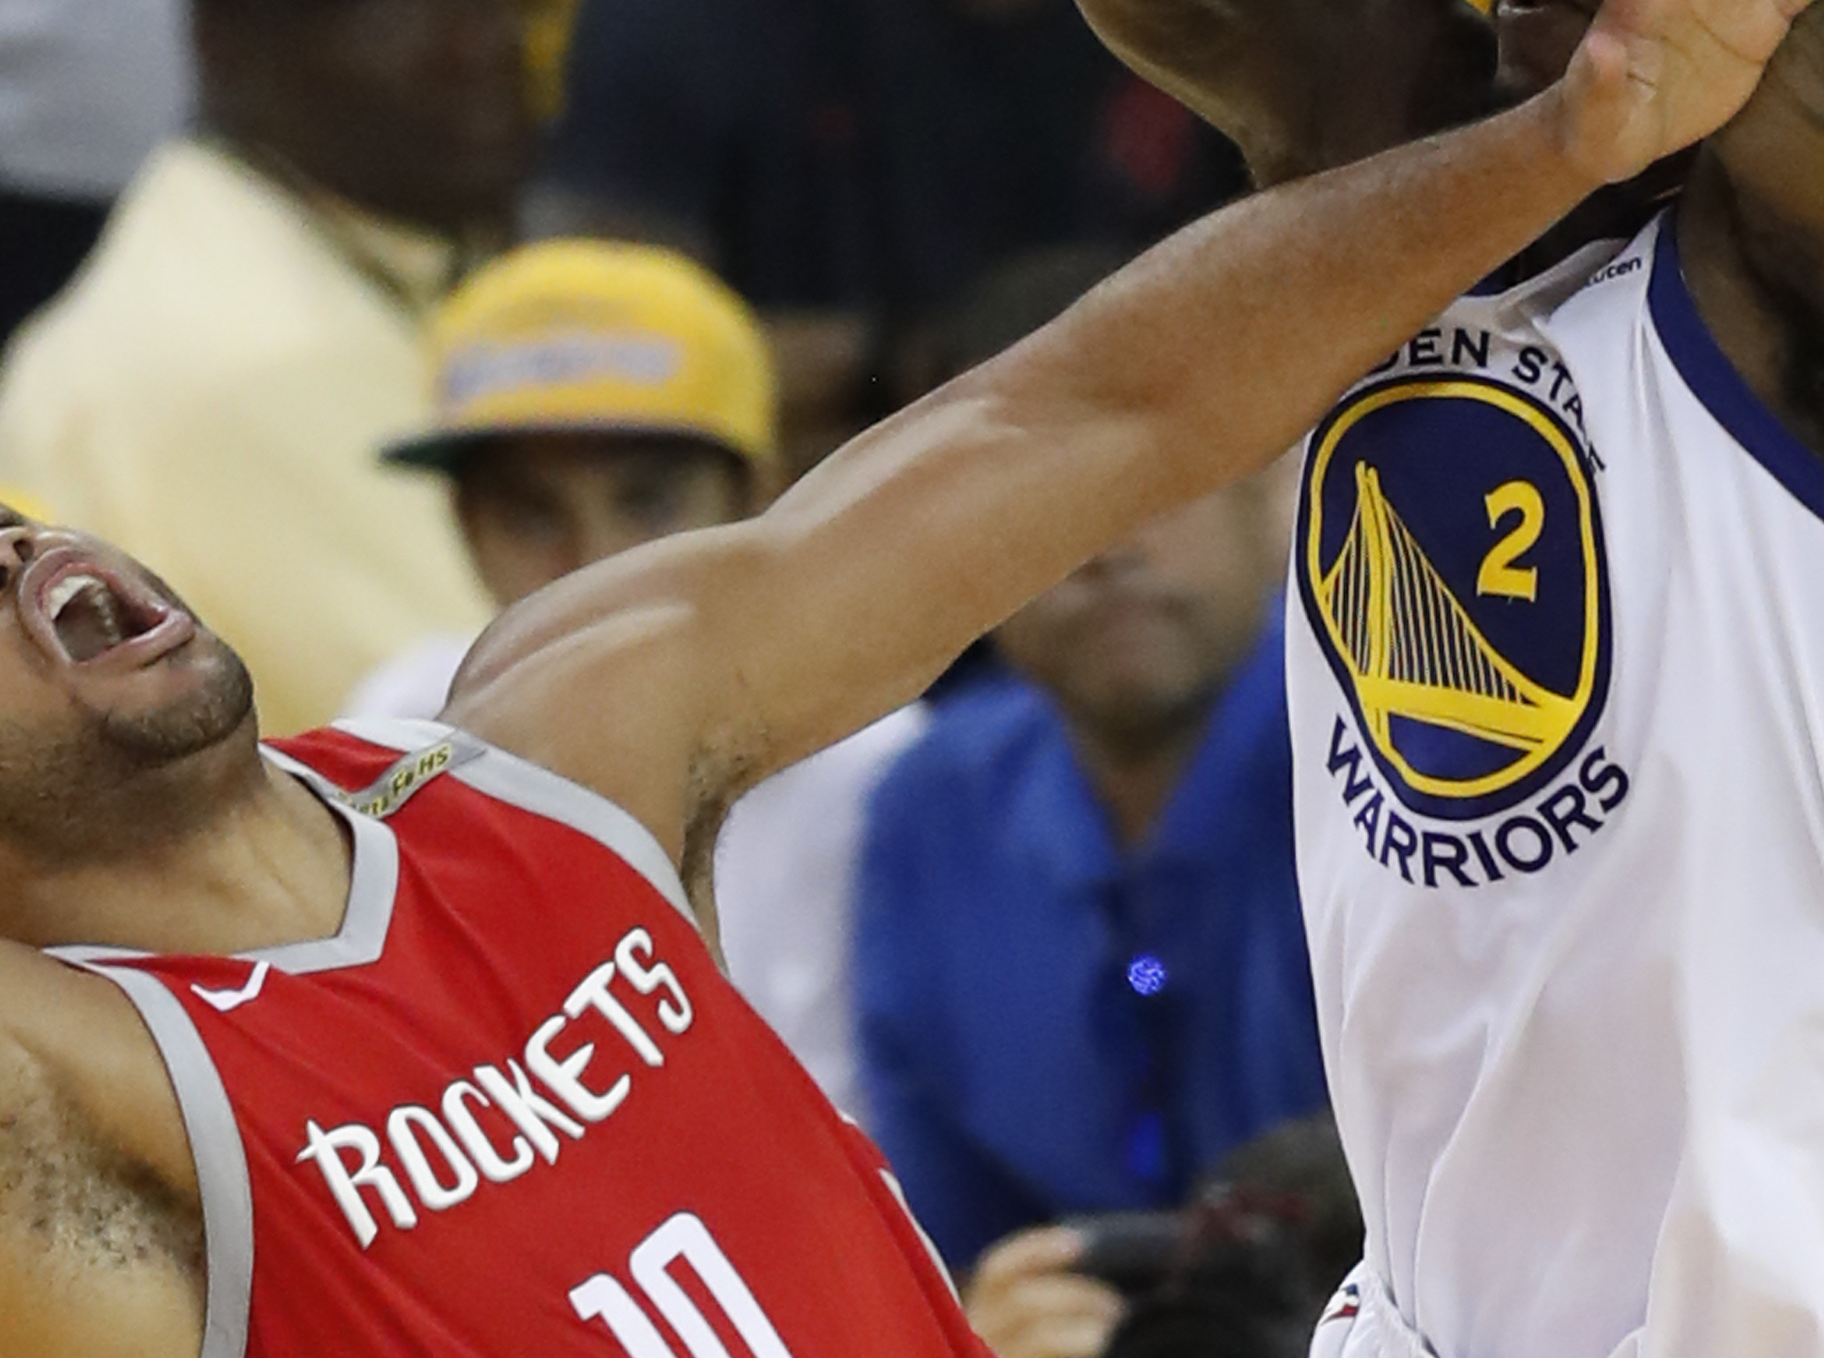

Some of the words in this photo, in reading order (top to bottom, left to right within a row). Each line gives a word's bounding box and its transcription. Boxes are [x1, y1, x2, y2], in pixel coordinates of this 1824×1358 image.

[1477, 480, 1546, 603] 2
[1326, 714, 1630, 888] WARRIORS
[295, 926, 694, 1250] ROCKETS
